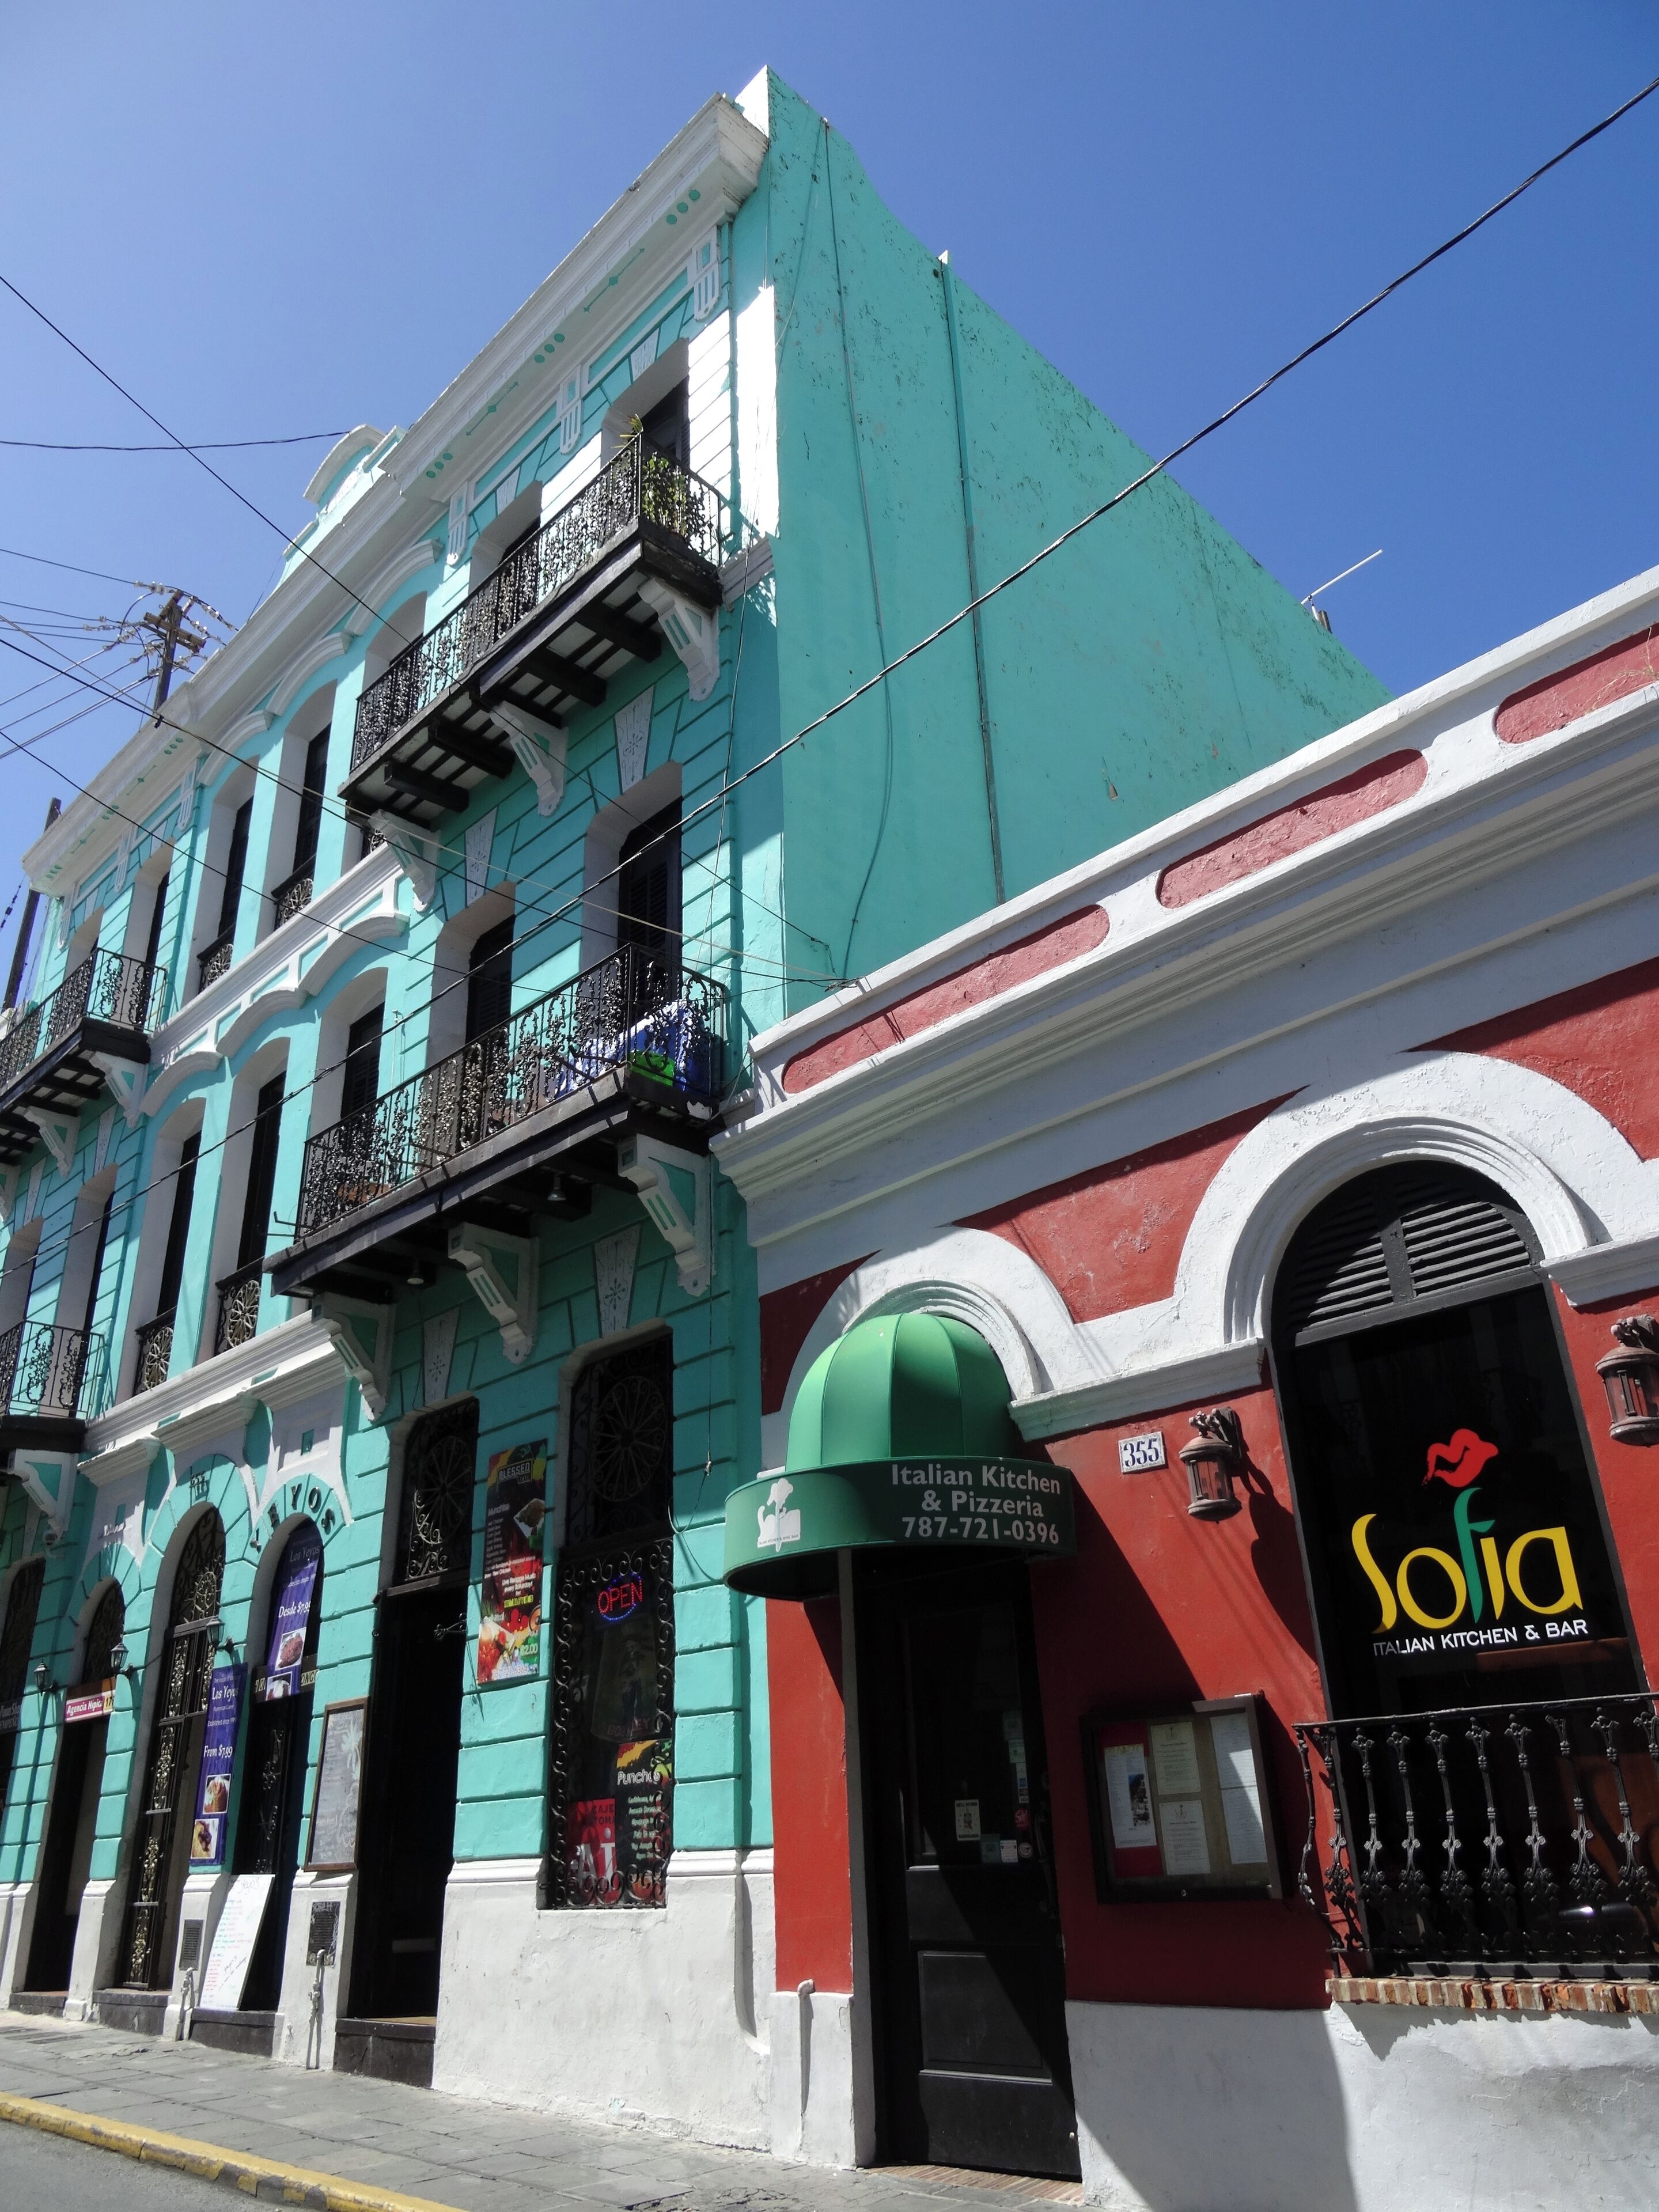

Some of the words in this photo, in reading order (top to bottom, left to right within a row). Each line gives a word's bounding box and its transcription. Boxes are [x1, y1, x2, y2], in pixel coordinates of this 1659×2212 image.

[1123, 1438, 1160, 1467] 355
[498, 1462, 531, 1481] BLESSED
[892, 1463, 973, 1485] Italian
[982, 1465, 1060, 1494] Kitchen
[921, 1489, 942, 1512] &
[951, 1490, 1044, 1517] Pizzeria
[902, 1516, 1059, 1544] 787-721-0396
[290, 1550, 301, 1562] Los
[302, 1545, 320, 1559] Yeyos
[1351, 1487, 1584, 1634] Sofia
[278, 1601, 296, 1618] Desde
[598, 1579, 643, 1613] OPEN
[1373, 1635, 1435, 1657] ITALIAN
[1441, 1626, 1518, 1649] KITCHEN
[1525, 1624, 1540, 1641] &
[1545, 1619, 1589, 1638] BAR
[211, 1687, 223, 1700] Los
[223, 1685, 239, 1702] Yeyos
[66, 1702, 87, 1717] Agencia
[203, 1745, 217, 1758] From
[218, 1743, 233, 1759] $7.99
